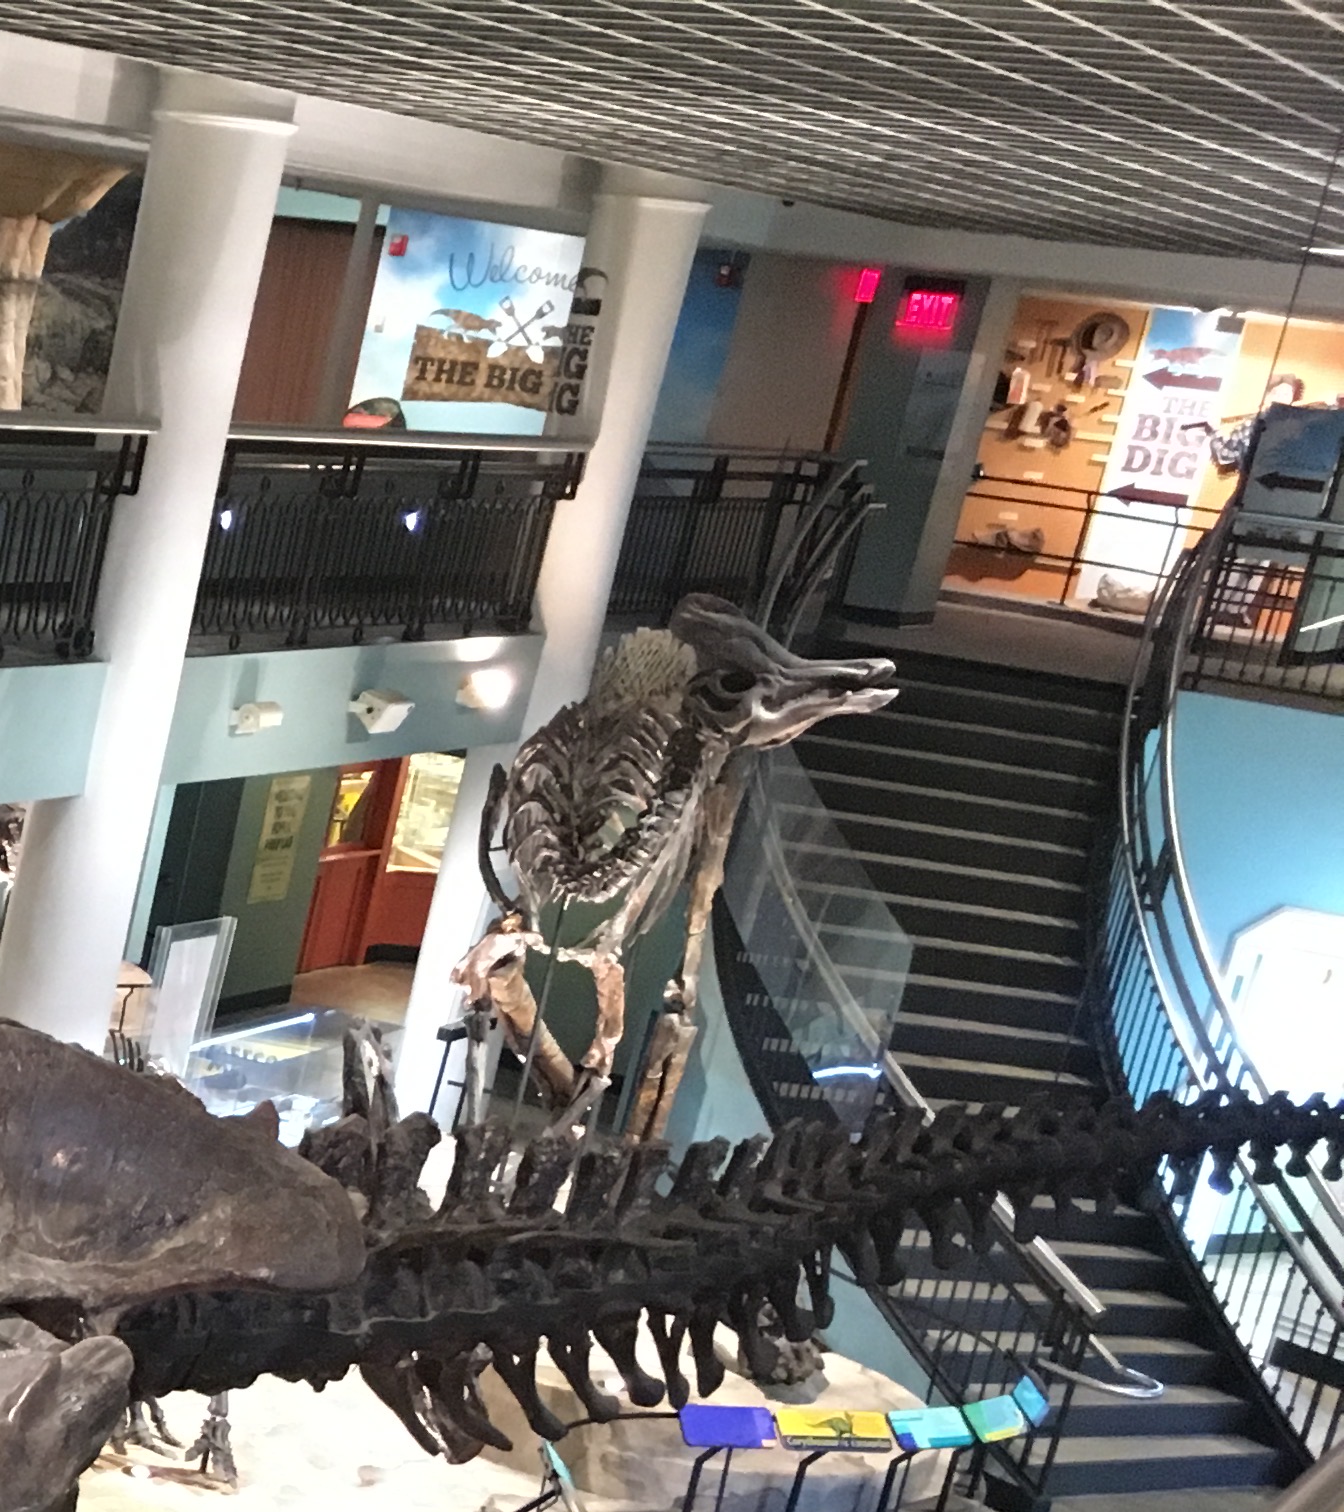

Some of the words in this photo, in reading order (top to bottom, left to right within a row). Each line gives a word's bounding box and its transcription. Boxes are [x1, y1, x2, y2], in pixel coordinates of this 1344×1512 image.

[448, 241, 579, 292] Welcome
[906, 292, 954, 326] EXIT
[414, 355, 480, 387] THE
[484, 363, 544, 395] BIG
[1163, 396, 1212, 419] THE
[1131, 413, 1206, 447] BIG
[1121, 444, 1199, 480] DIG
